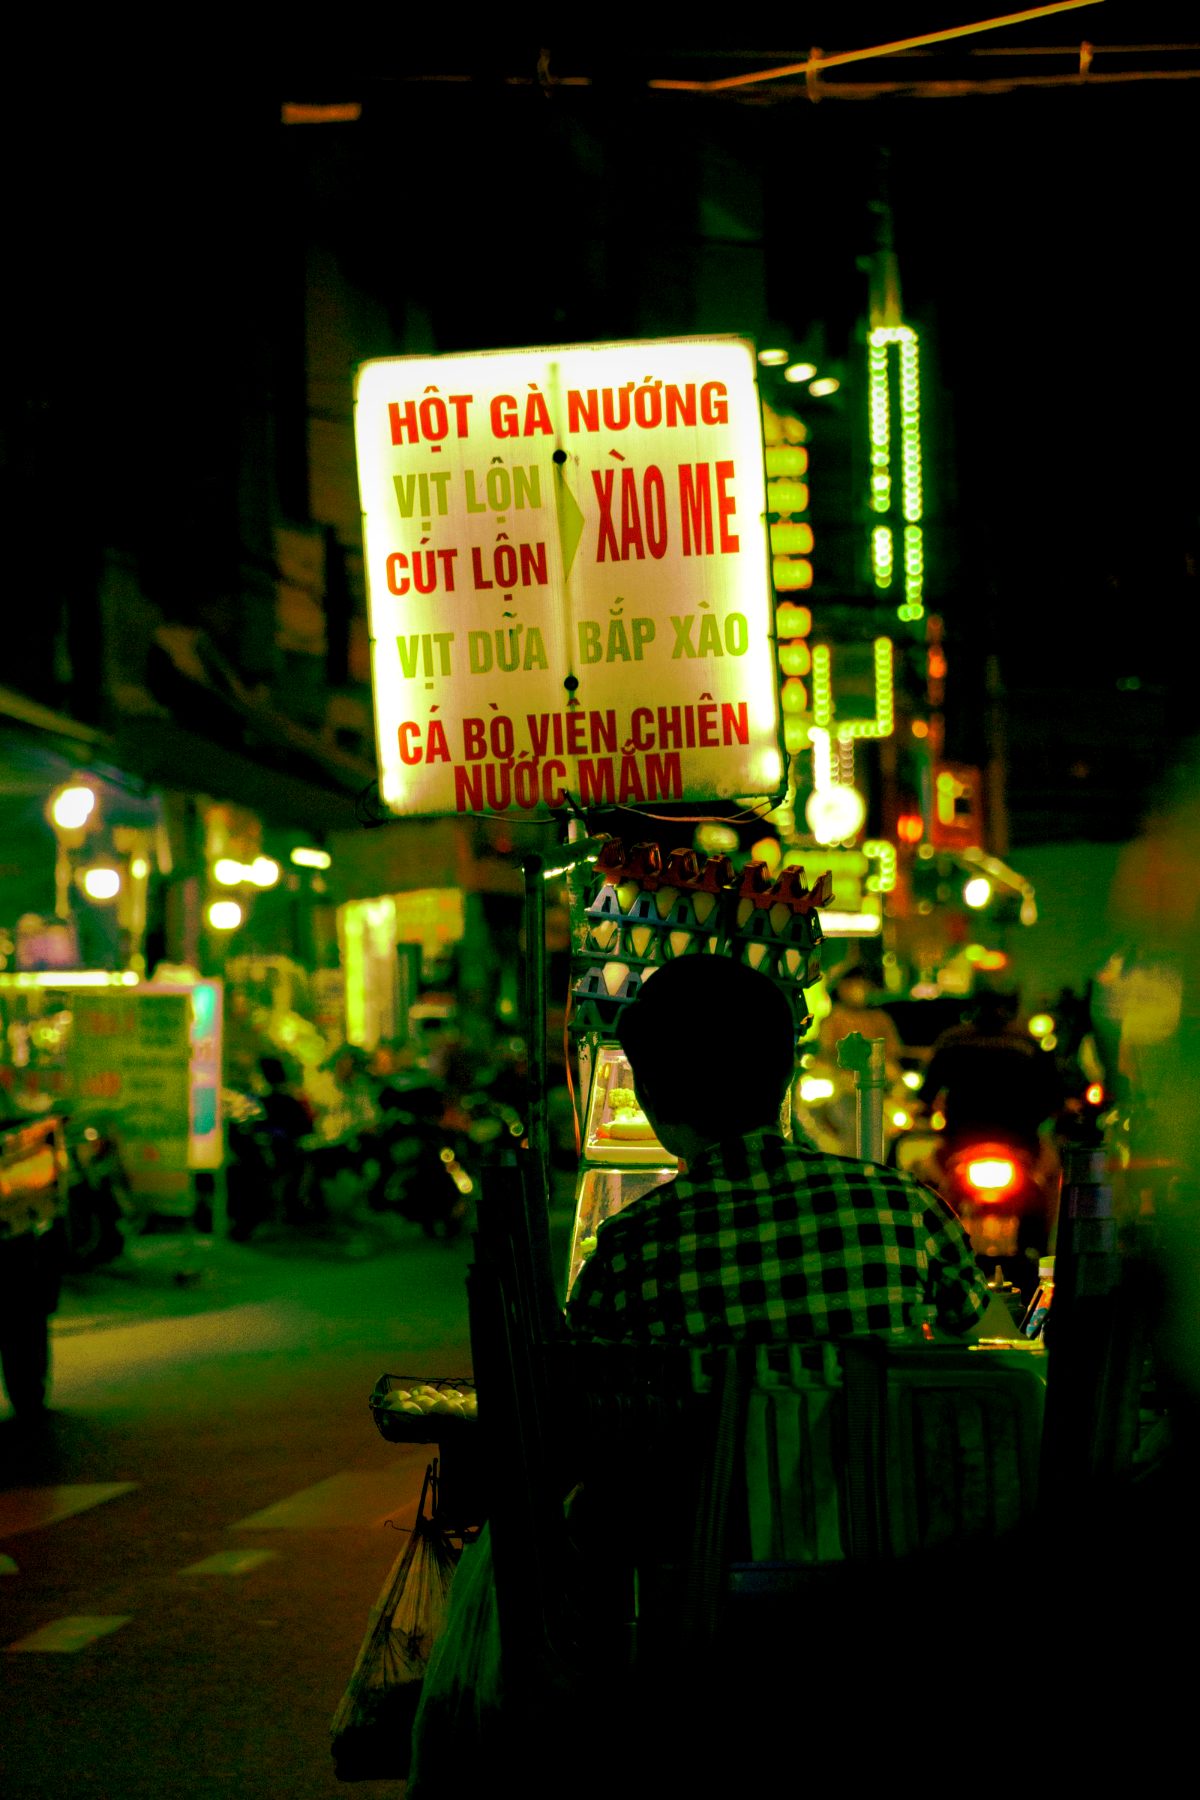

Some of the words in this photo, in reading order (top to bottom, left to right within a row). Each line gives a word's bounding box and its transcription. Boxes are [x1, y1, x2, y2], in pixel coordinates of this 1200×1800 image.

[388, 385, 473, 453] HỘT
[490, 383, 554, 439] GÀ
[567, 375, 729, 434] NƯỚNG
[393, 471, 451, 532] VỊT
[464, 456, 542, 524] LỘN
[591, 449, 668, 563] XÀO
[678, 460, 740, 557] ME
[386, 537, 458, 595] CÚT
[472, 532, 548, 601] LỘN
[396, 632, 455, 690] VỊT
[577, 597, 656, 665] BẮP
[670, 600, 749, 660] XÀO
[397, 704, 452, 765] CÁ
[462, 703, 515, 761] BÒ
[527, 697, 618, 757] VIÊN
[631, 692, 750, 751] CHIÊN
[454, 750, 567, 813] NƯỚC
[577, 738, 684, 807] MẮM
